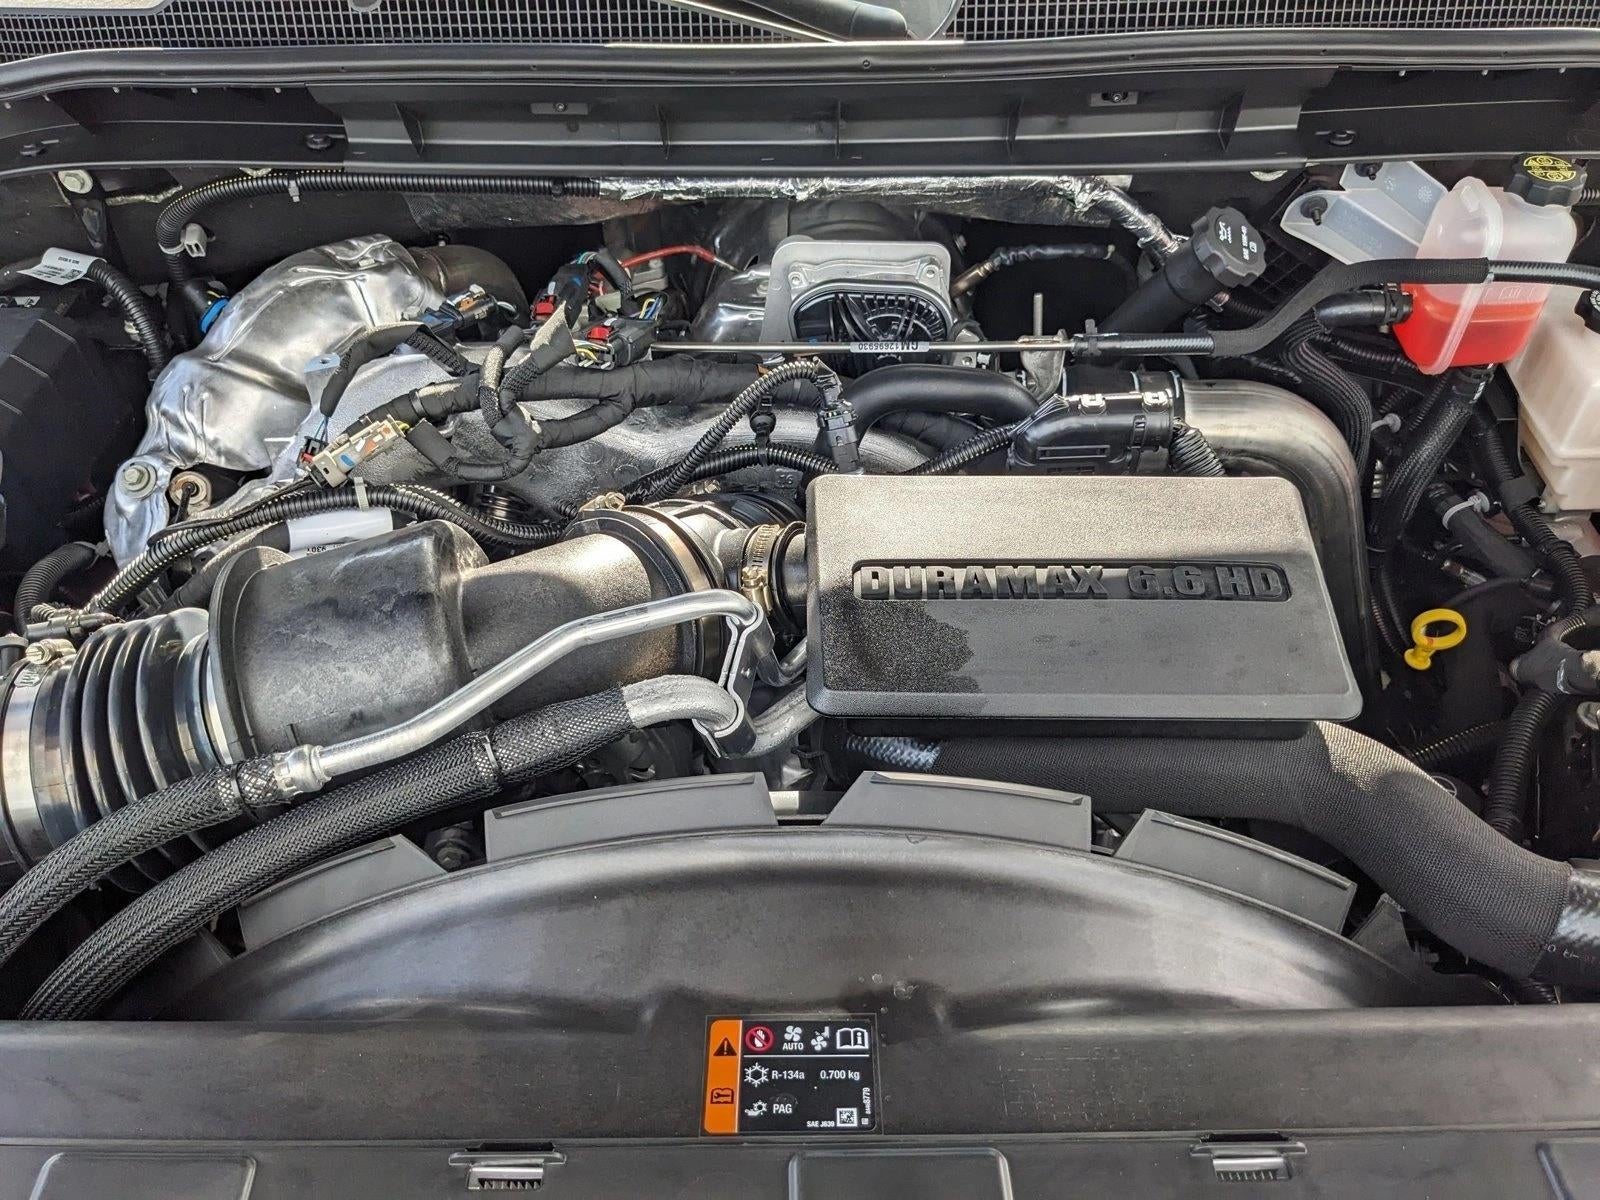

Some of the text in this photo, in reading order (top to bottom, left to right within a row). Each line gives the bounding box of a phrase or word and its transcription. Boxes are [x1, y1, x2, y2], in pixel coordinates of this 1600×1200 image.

[901, 341, 919, 350] GM
[860, 565, 1284, 599] DURAMAX 6.6 HD
[782, 1042, 804, 1050] AUTO
[771, 1070, 805, 1080] R-134a
[820, 1070, 860, 1081] 0.700 kg
[772, 1104, 793, 1114] PAG
